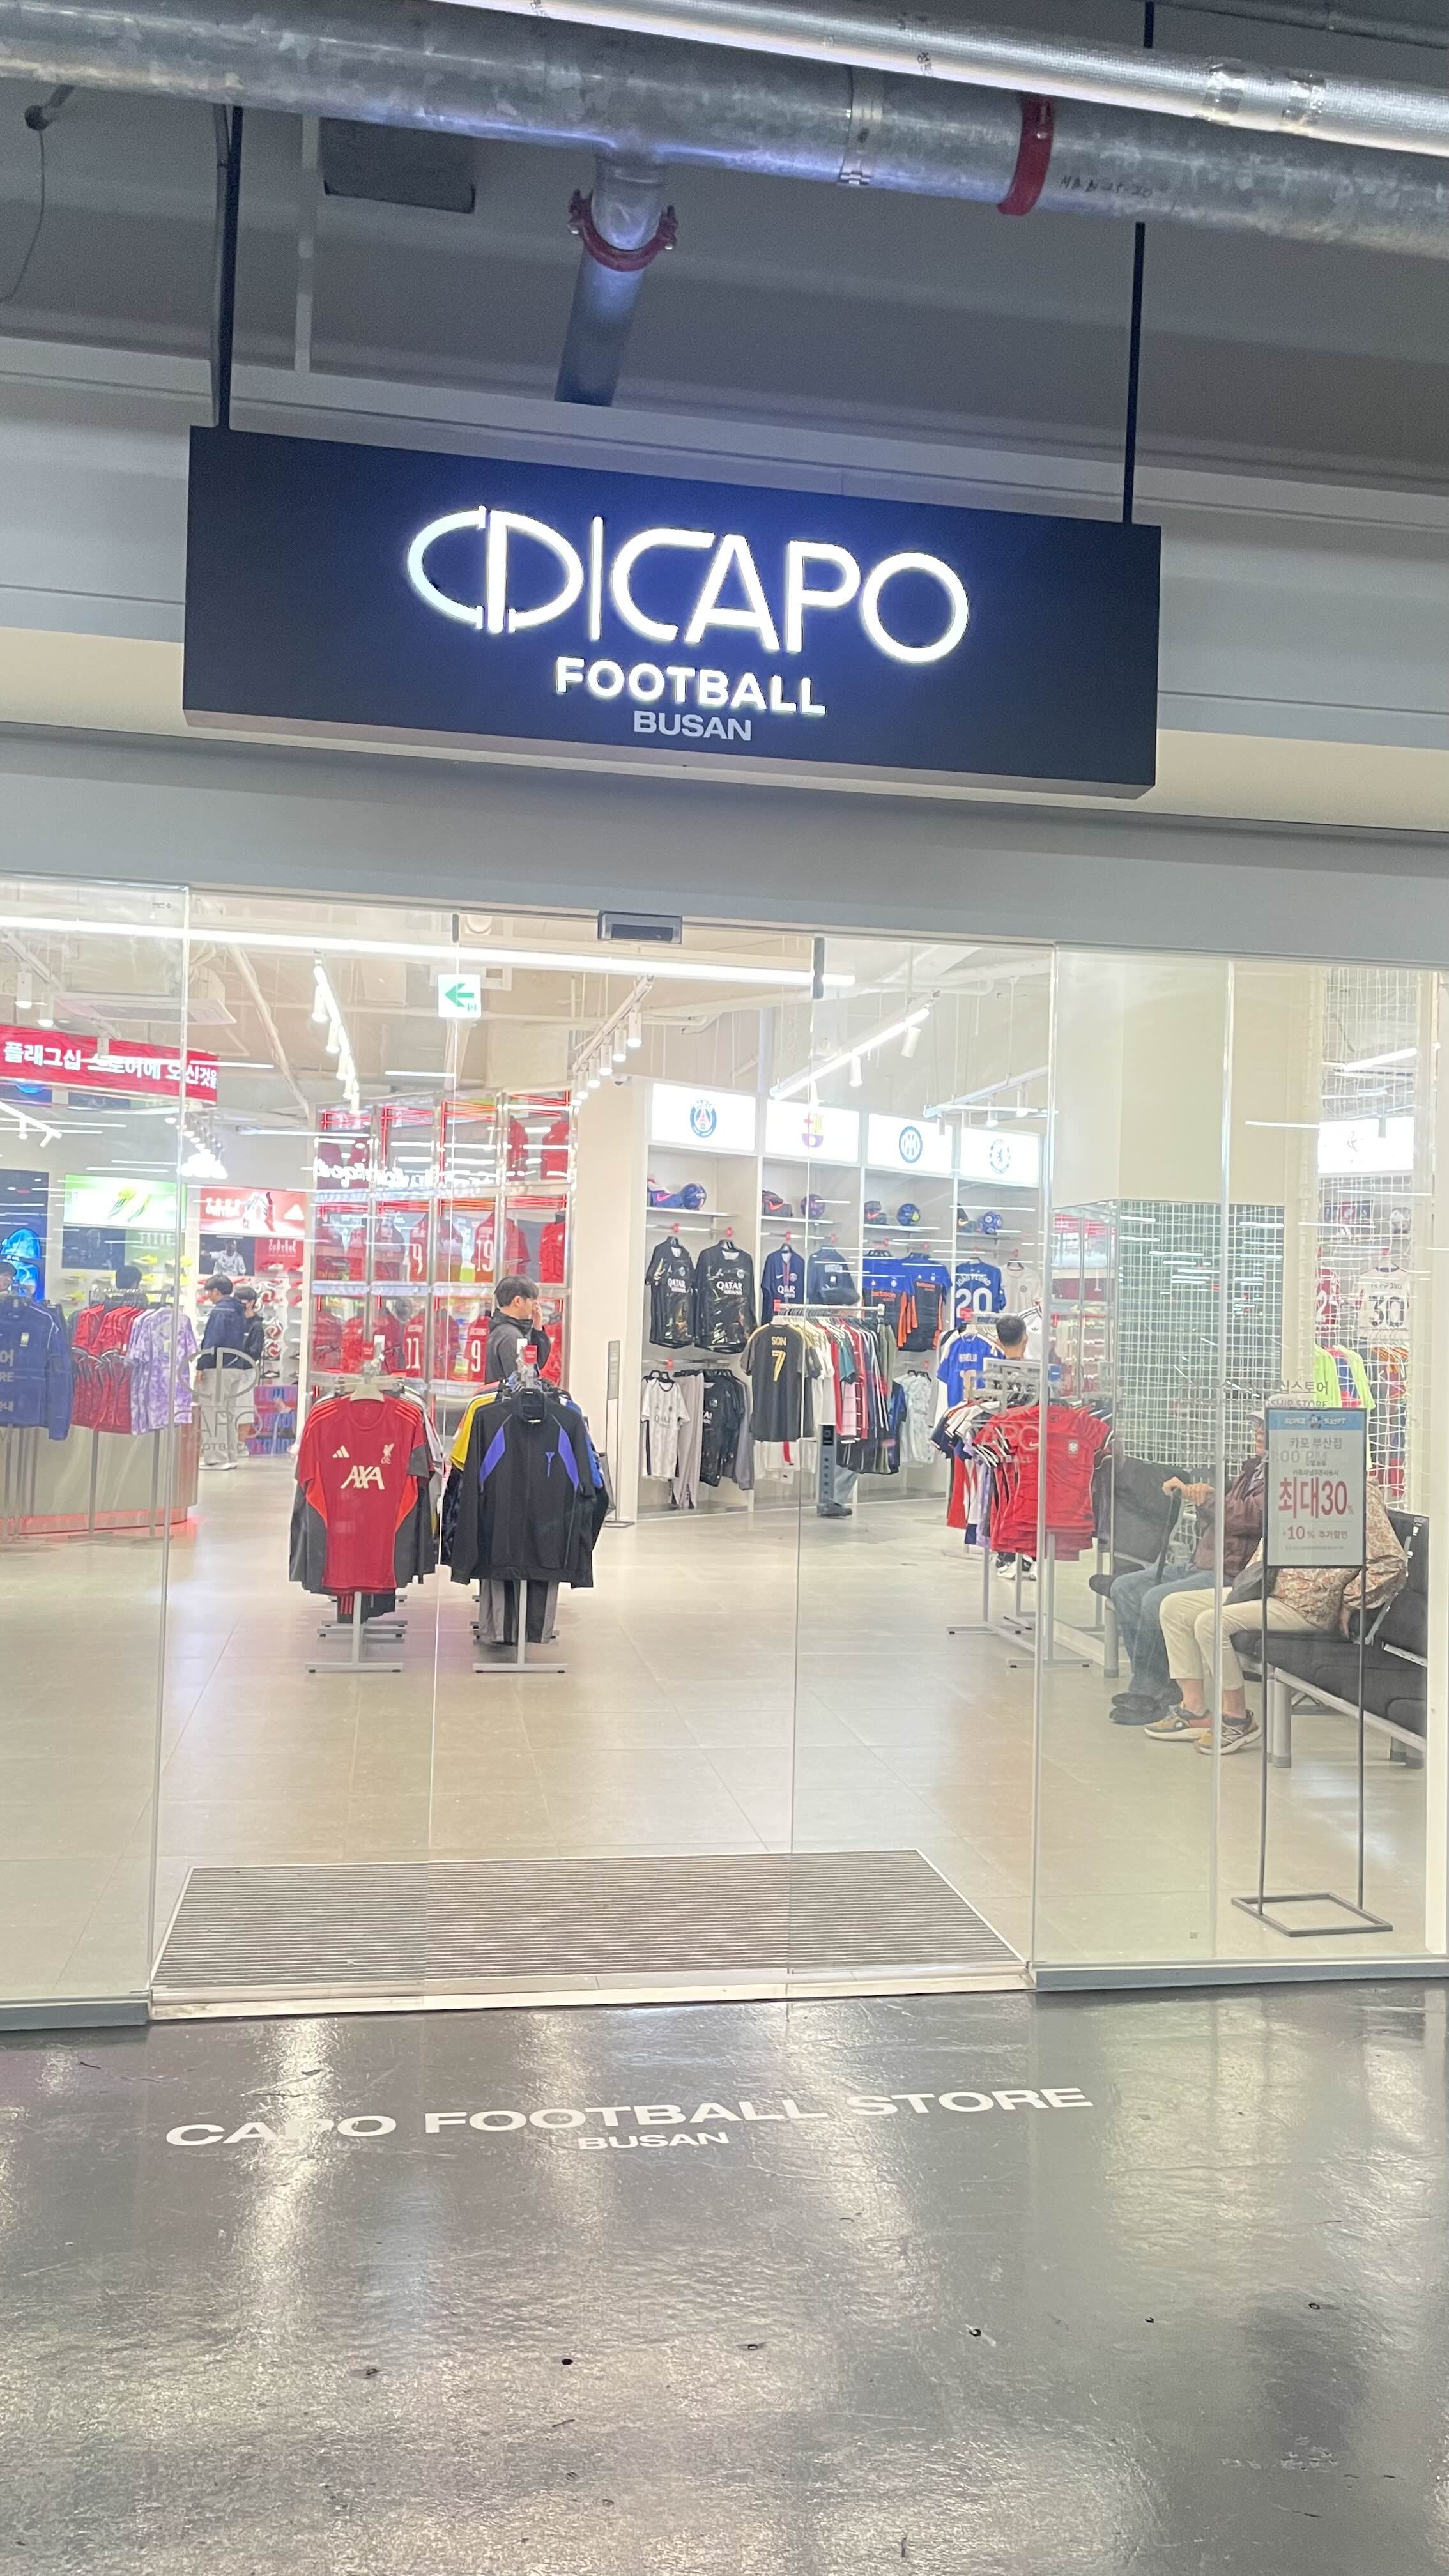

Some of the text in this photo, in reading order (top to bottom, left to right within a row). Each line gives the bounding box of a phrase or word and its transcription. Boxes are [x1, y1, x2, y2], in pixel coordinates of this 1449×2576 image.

[610, 526, 970, 664] CAPO
[555, 656, 827, 715] FOOTBALL
[633, 710, 753, 742] BUSAN
[3, 1041, 82, 1071] 플래그십
[716, 1280, 743, 1291] QATAR
[955, 1287, 993, 1318] 20
[1368, 1295, 1405, 1328] 30
[771, 1336, 787, 1346] SON
[771, 1349, 786, 1381] 7
[1313, 1437, 1343, 1450] 부산점
[339, 1465, 386, 1490] AXA
[165, 2087, 1094, 2147] CAPO FOOTBALL STORE
[578, 2131, 730, 2150] BUSAN
